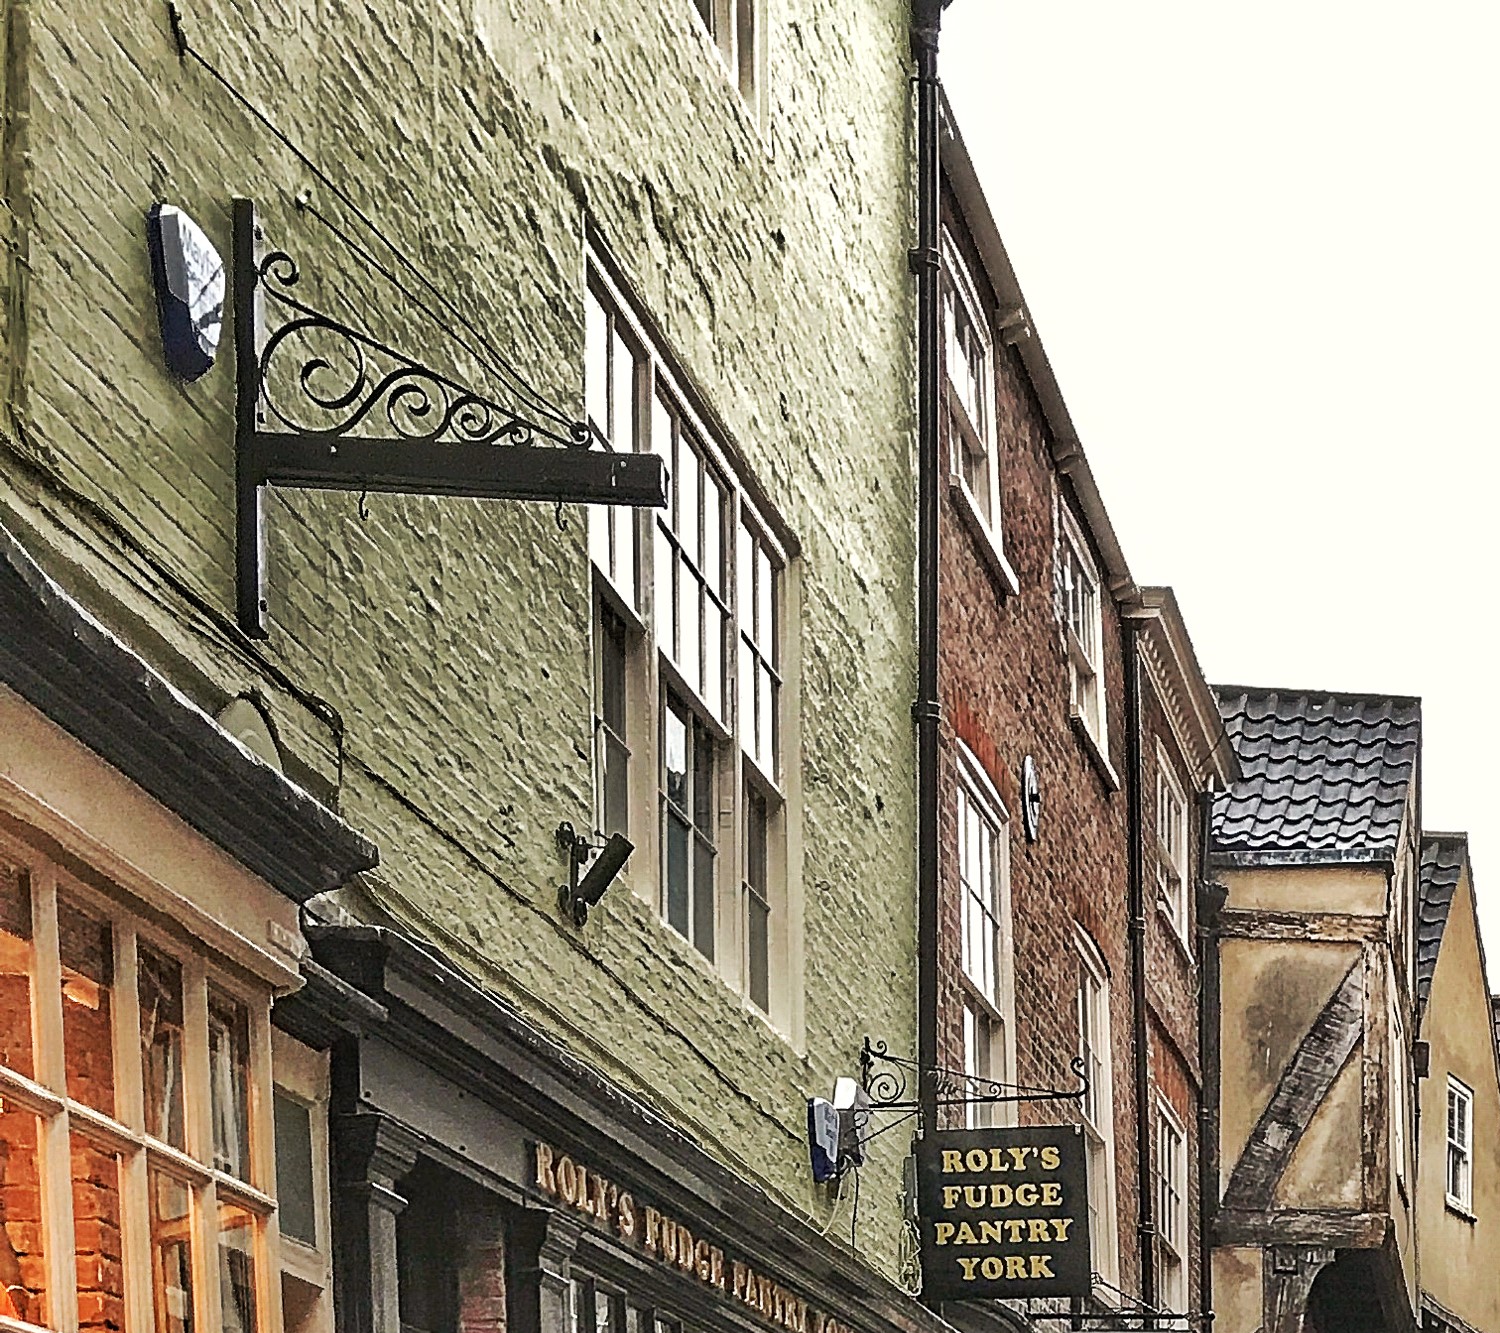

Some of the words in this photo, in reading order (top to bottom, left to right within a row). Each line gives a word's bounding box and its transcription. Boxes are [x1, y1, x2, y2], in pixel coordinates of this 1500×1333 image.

[941, 1146, 1061, 1173] ROLY'S
[942, 1182, 1064, 1209] FUDGE
[535, 1140, 635, 1237] ROLY'S
[645, 1205, 726, 1290] FUDGE
[934, 1217, 1074, 1246] PANTRY
[956, 1255, 1056, 1281] YORK
